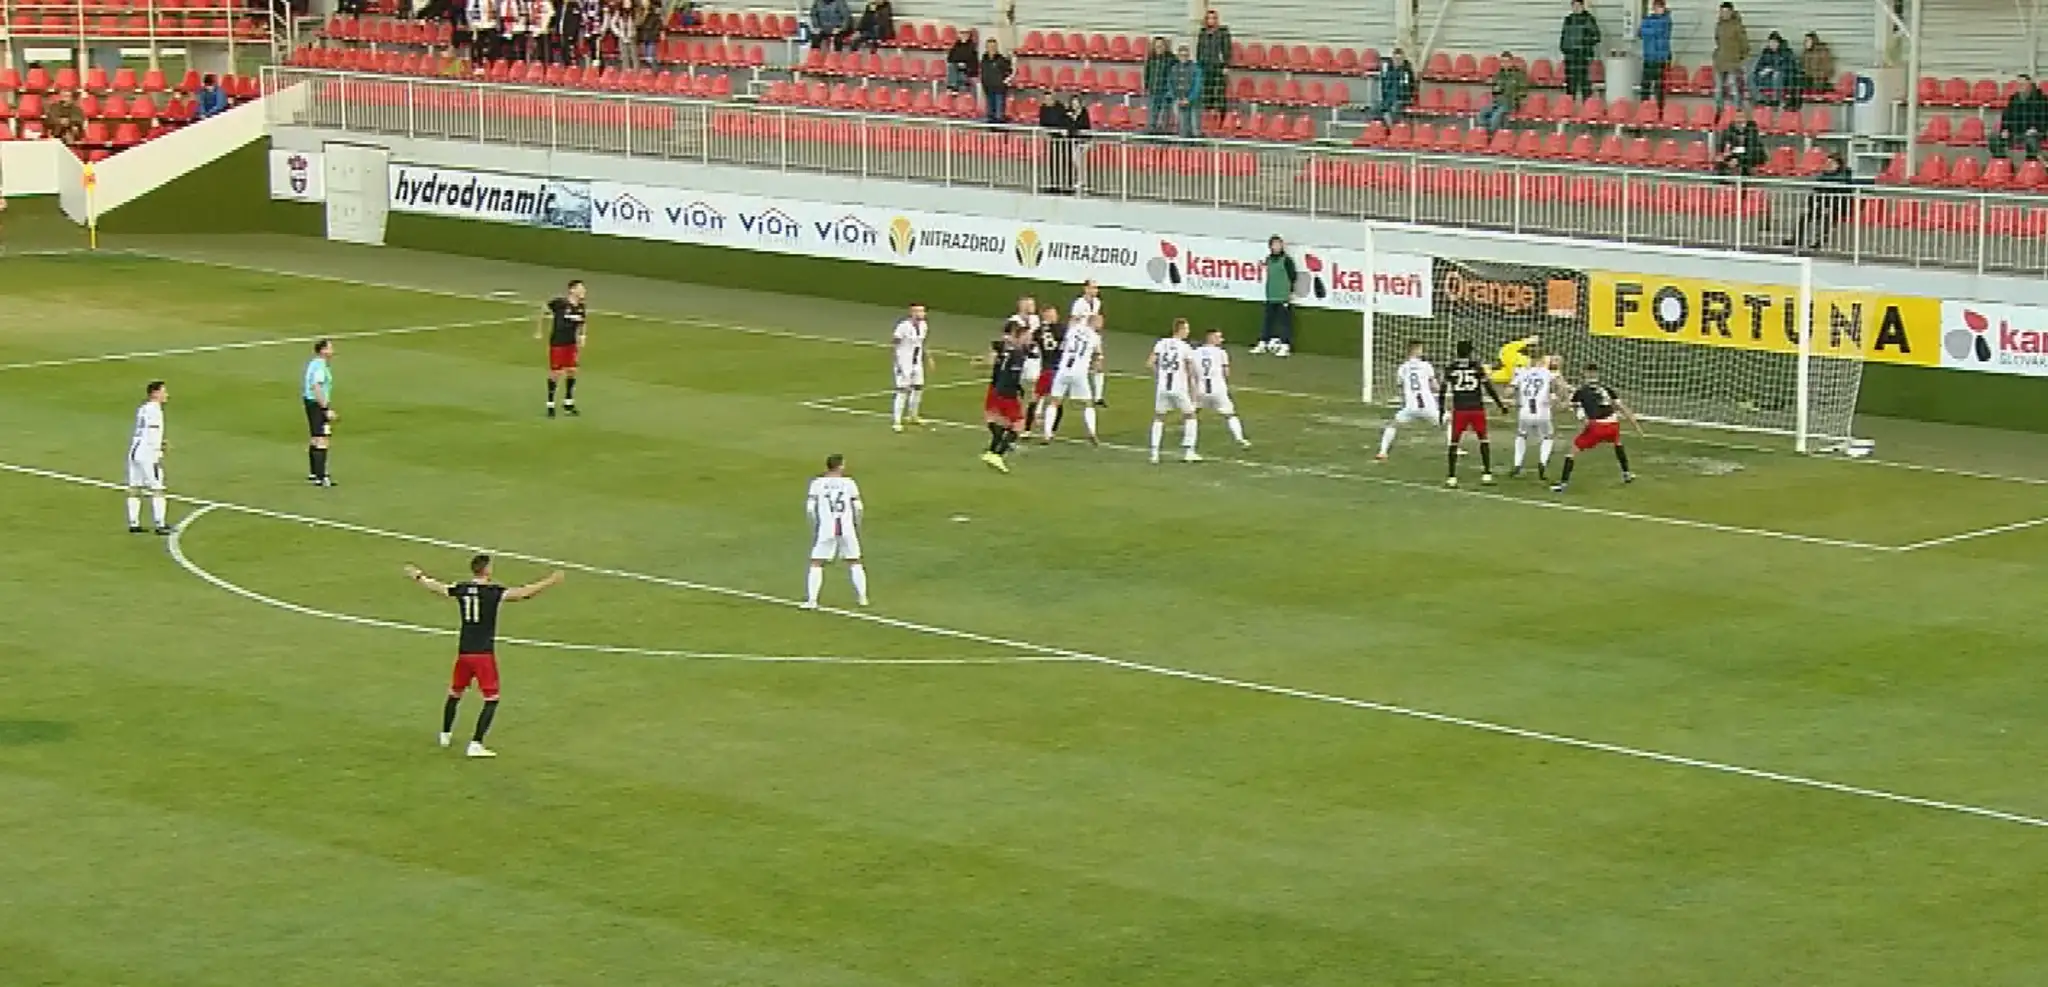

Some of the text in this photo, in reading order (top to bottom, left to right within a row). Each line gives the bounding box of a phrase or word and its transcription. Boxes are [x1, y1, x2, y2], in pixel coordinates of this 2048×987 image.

[1855, 76, 1875, 104] D
[395, 169, 556, 215] hydrodynamic
[920, 229, 1006, 254] NITRAZDROJ
[1048, 241, 1138, 267] NITRAZDROJ
[1444, 270, 1534, 313] Orange
[1614, 285, 1911, 353] FORTUNA
[1450, 369, 1479, 391] 25
[824, 491, 845, 513] 16
[463, 595, 481, 623] 11
